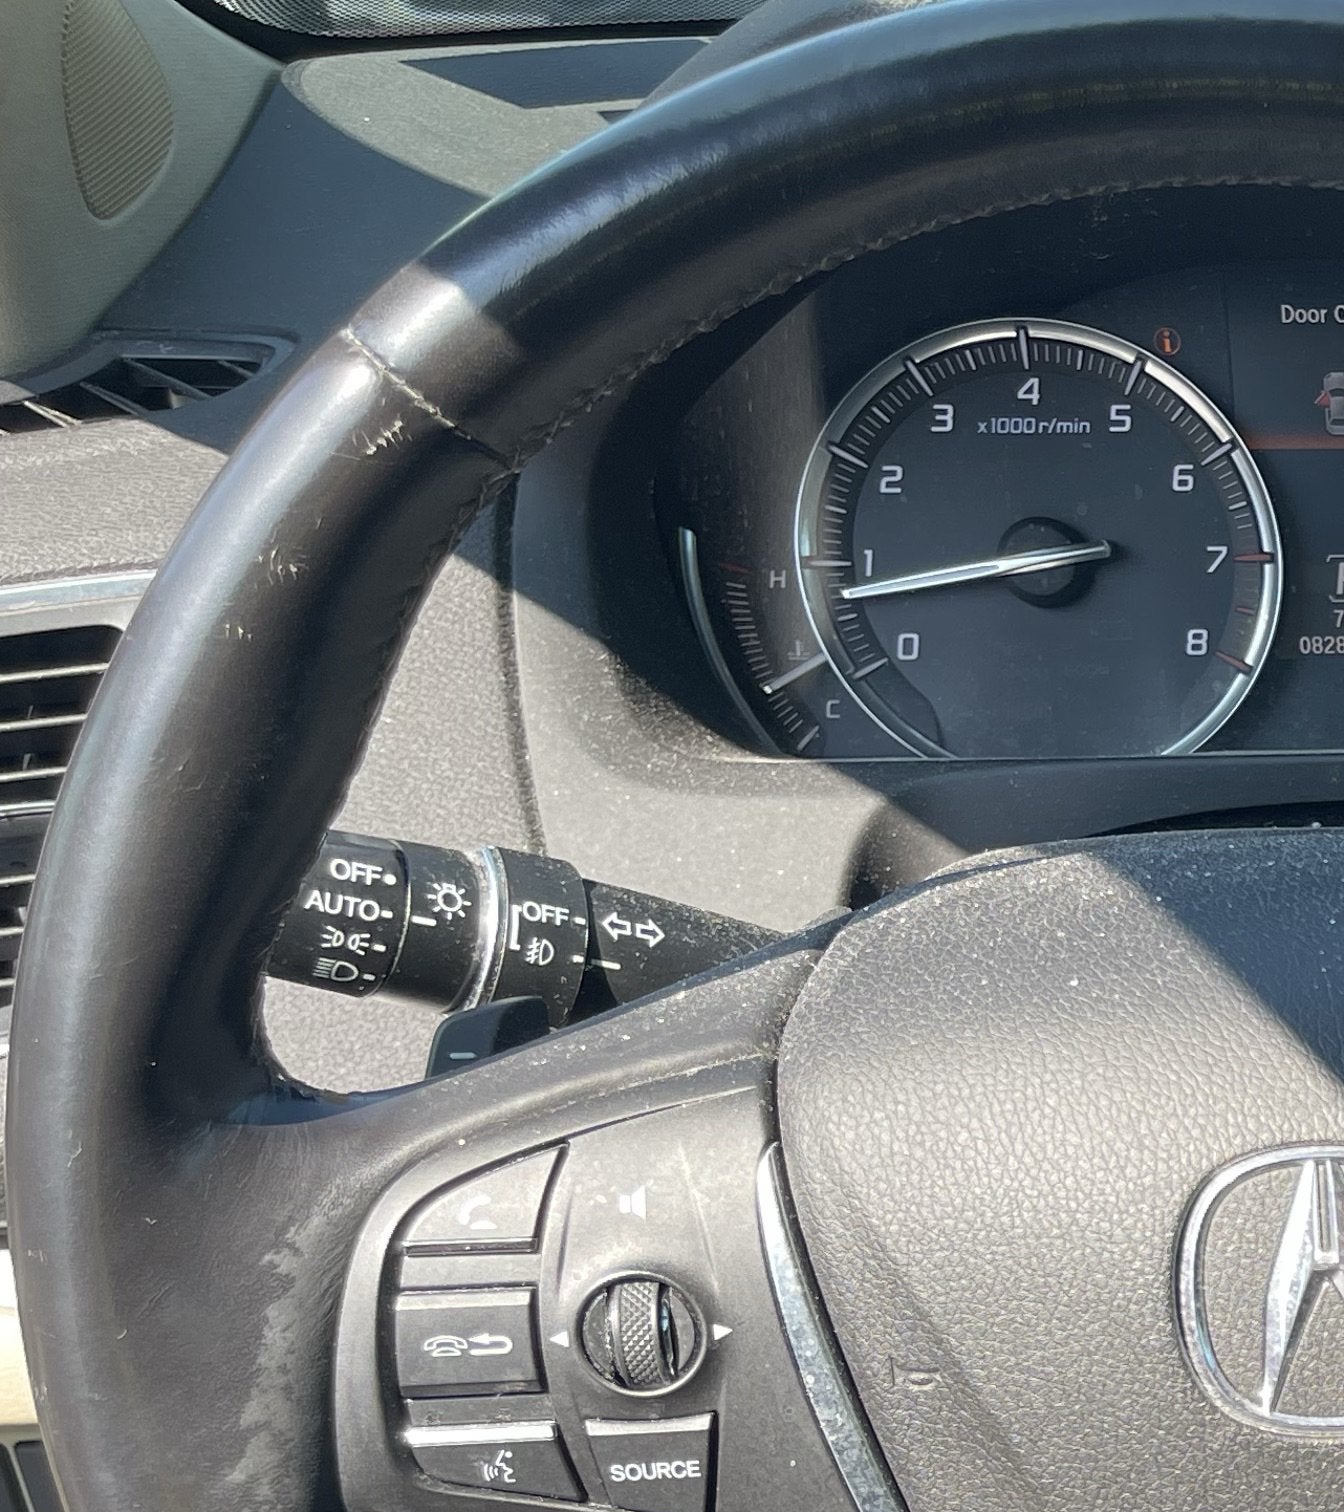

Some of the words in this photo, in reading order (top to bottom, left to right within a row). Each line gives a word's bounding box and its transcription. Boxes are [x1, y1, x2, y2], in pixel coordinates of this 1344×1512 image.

[1280, 304, 1328, 326] Door
[1017, 377, 1041, 405] 4
[930, 404, 955, 432] 3
[1038, 416, 1091, 435] r/min
[1109, 404, 1132, 432] 5
[880, 466, 903, 494] 2
[1172, 465, 1195, 492] 6
[863, 549, 874, 577] 1
[1206, 546, 1228, 574] 7
[769, 570, 787, 589] H
[898, 634, 920, 661] 0
[1186, 629, 1209, 656] 8
[826, 701, 840, 719] C
[329, 857, 383, 886] OFF
[303, 890, 381, 922] AUTO
[522, 900, 571, 927] OFF
[609, 1459, 702, 1483] SOURCE
